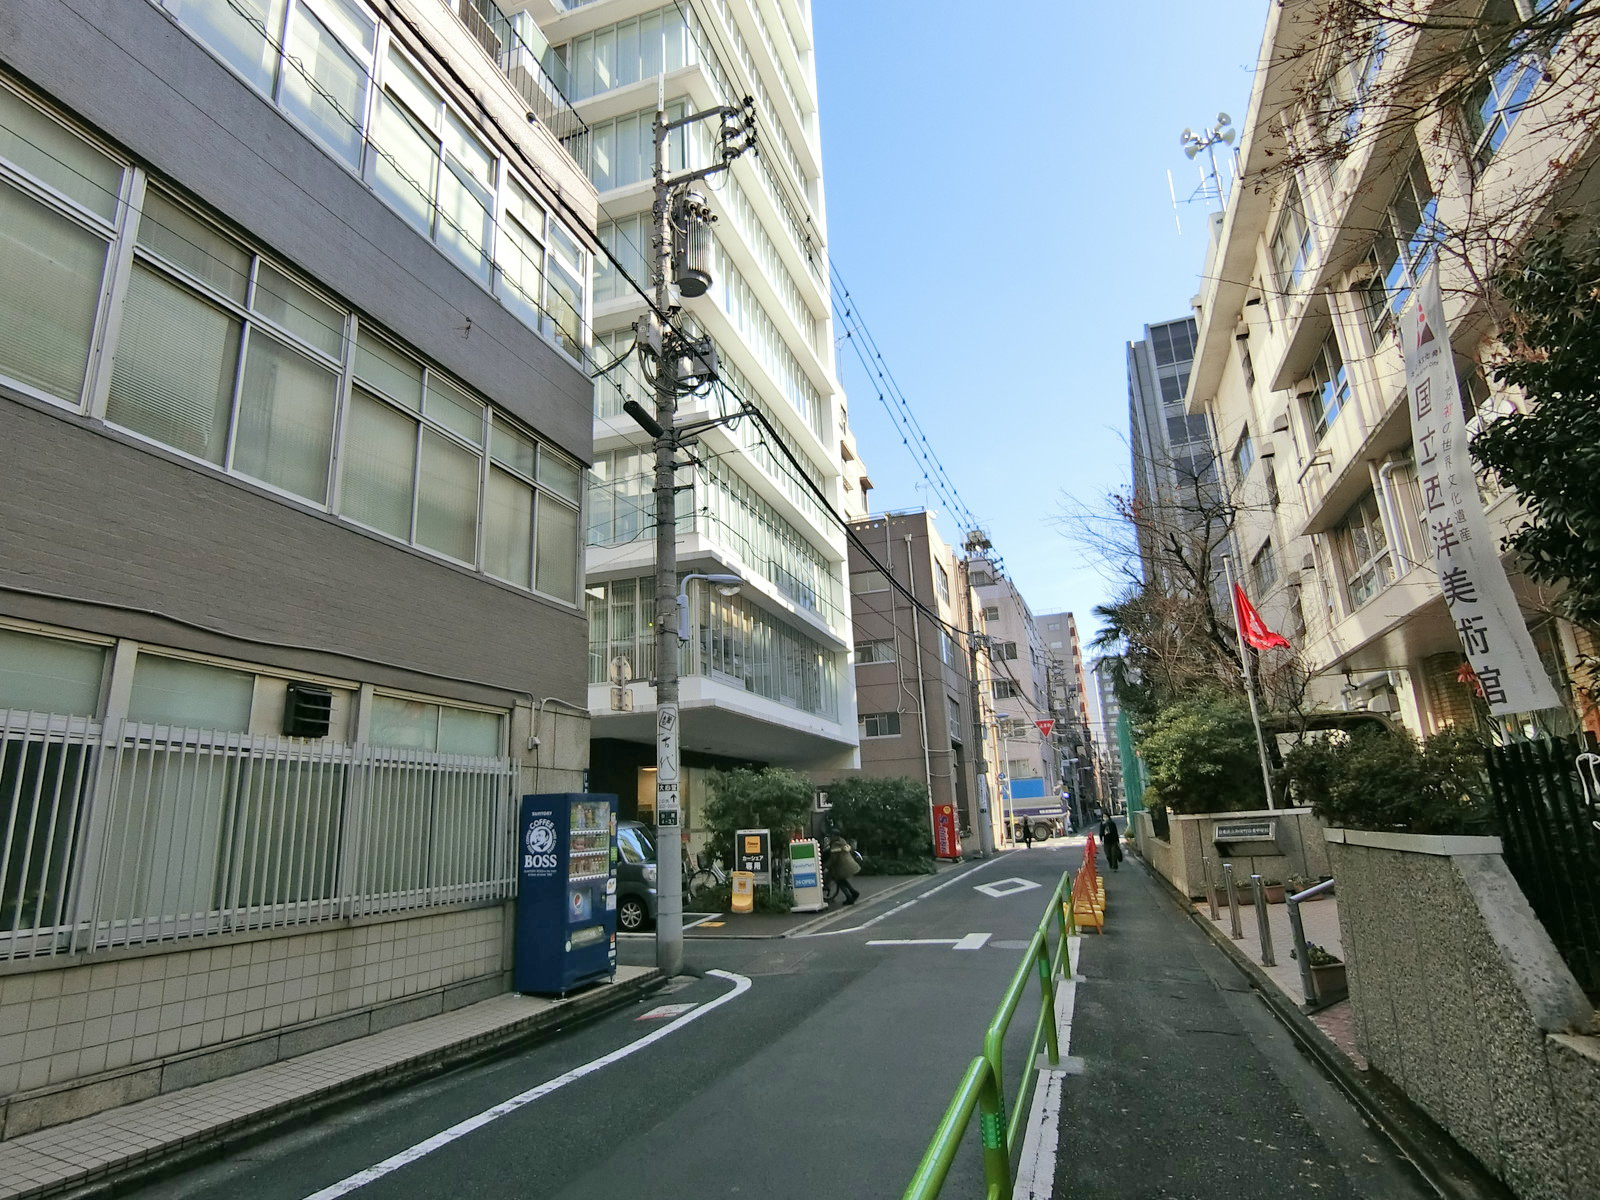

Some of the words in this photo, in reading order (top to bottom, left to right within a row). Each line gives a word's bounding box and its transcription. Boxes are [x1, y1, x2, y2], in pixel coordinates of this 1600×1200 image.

[529, 818, 555, 830] COFFEE
[524, 854, 558, 868] BOSS
[745, 861, 761, 870] 専用
